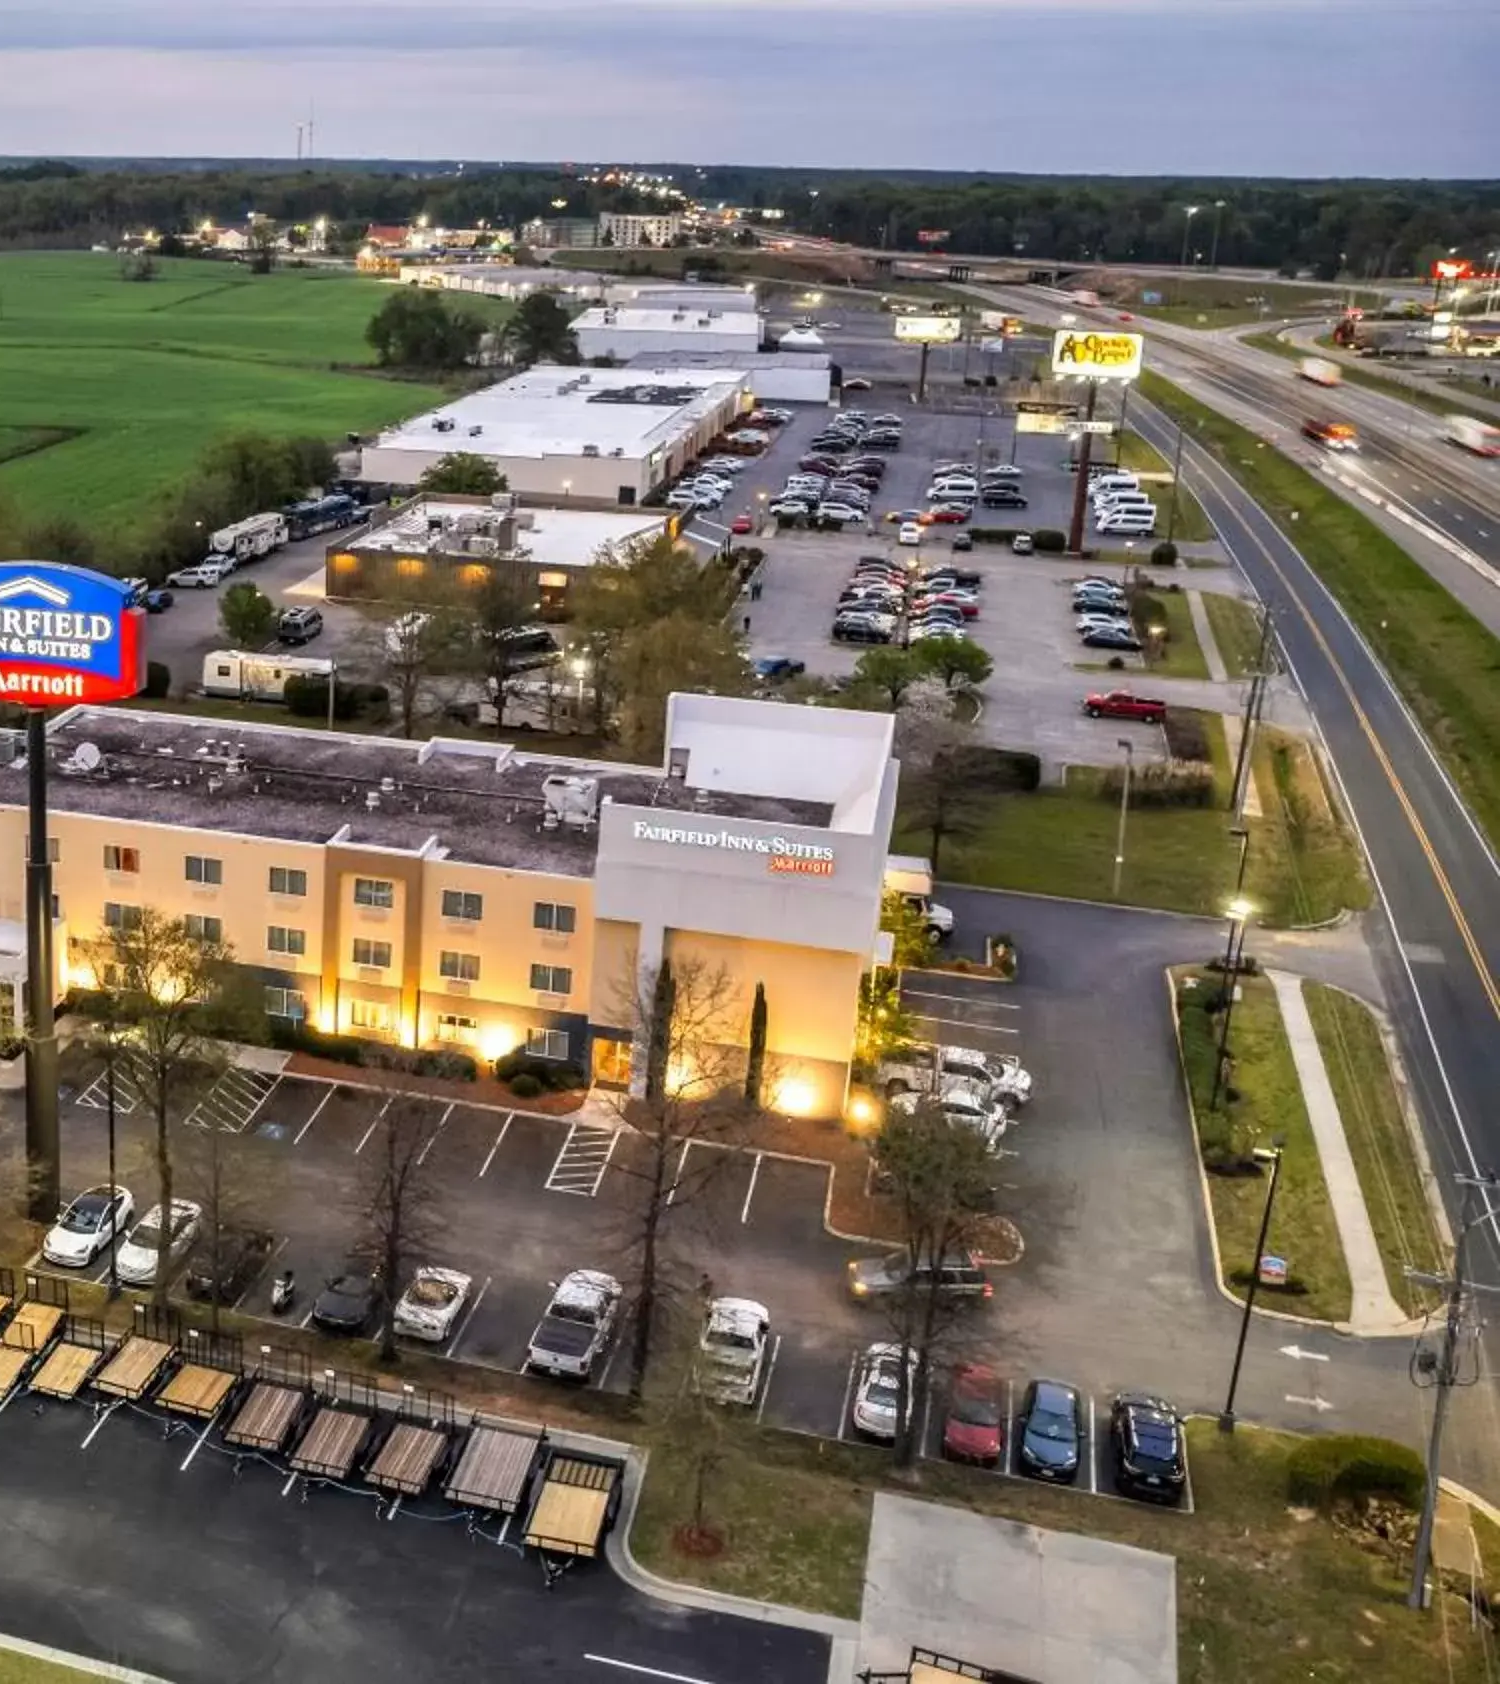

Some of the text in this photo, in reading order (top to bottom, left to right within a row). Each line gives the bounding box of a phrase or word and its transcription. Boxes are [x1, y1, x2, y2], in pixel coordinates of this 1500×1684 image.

[9, 637, 24, 653] &
[27, 639, 91, 659] SUITES
[633, 821, 834, 861] FAIRFIELD INN & SUITES
[770, 856, 833, 874] Marriott
